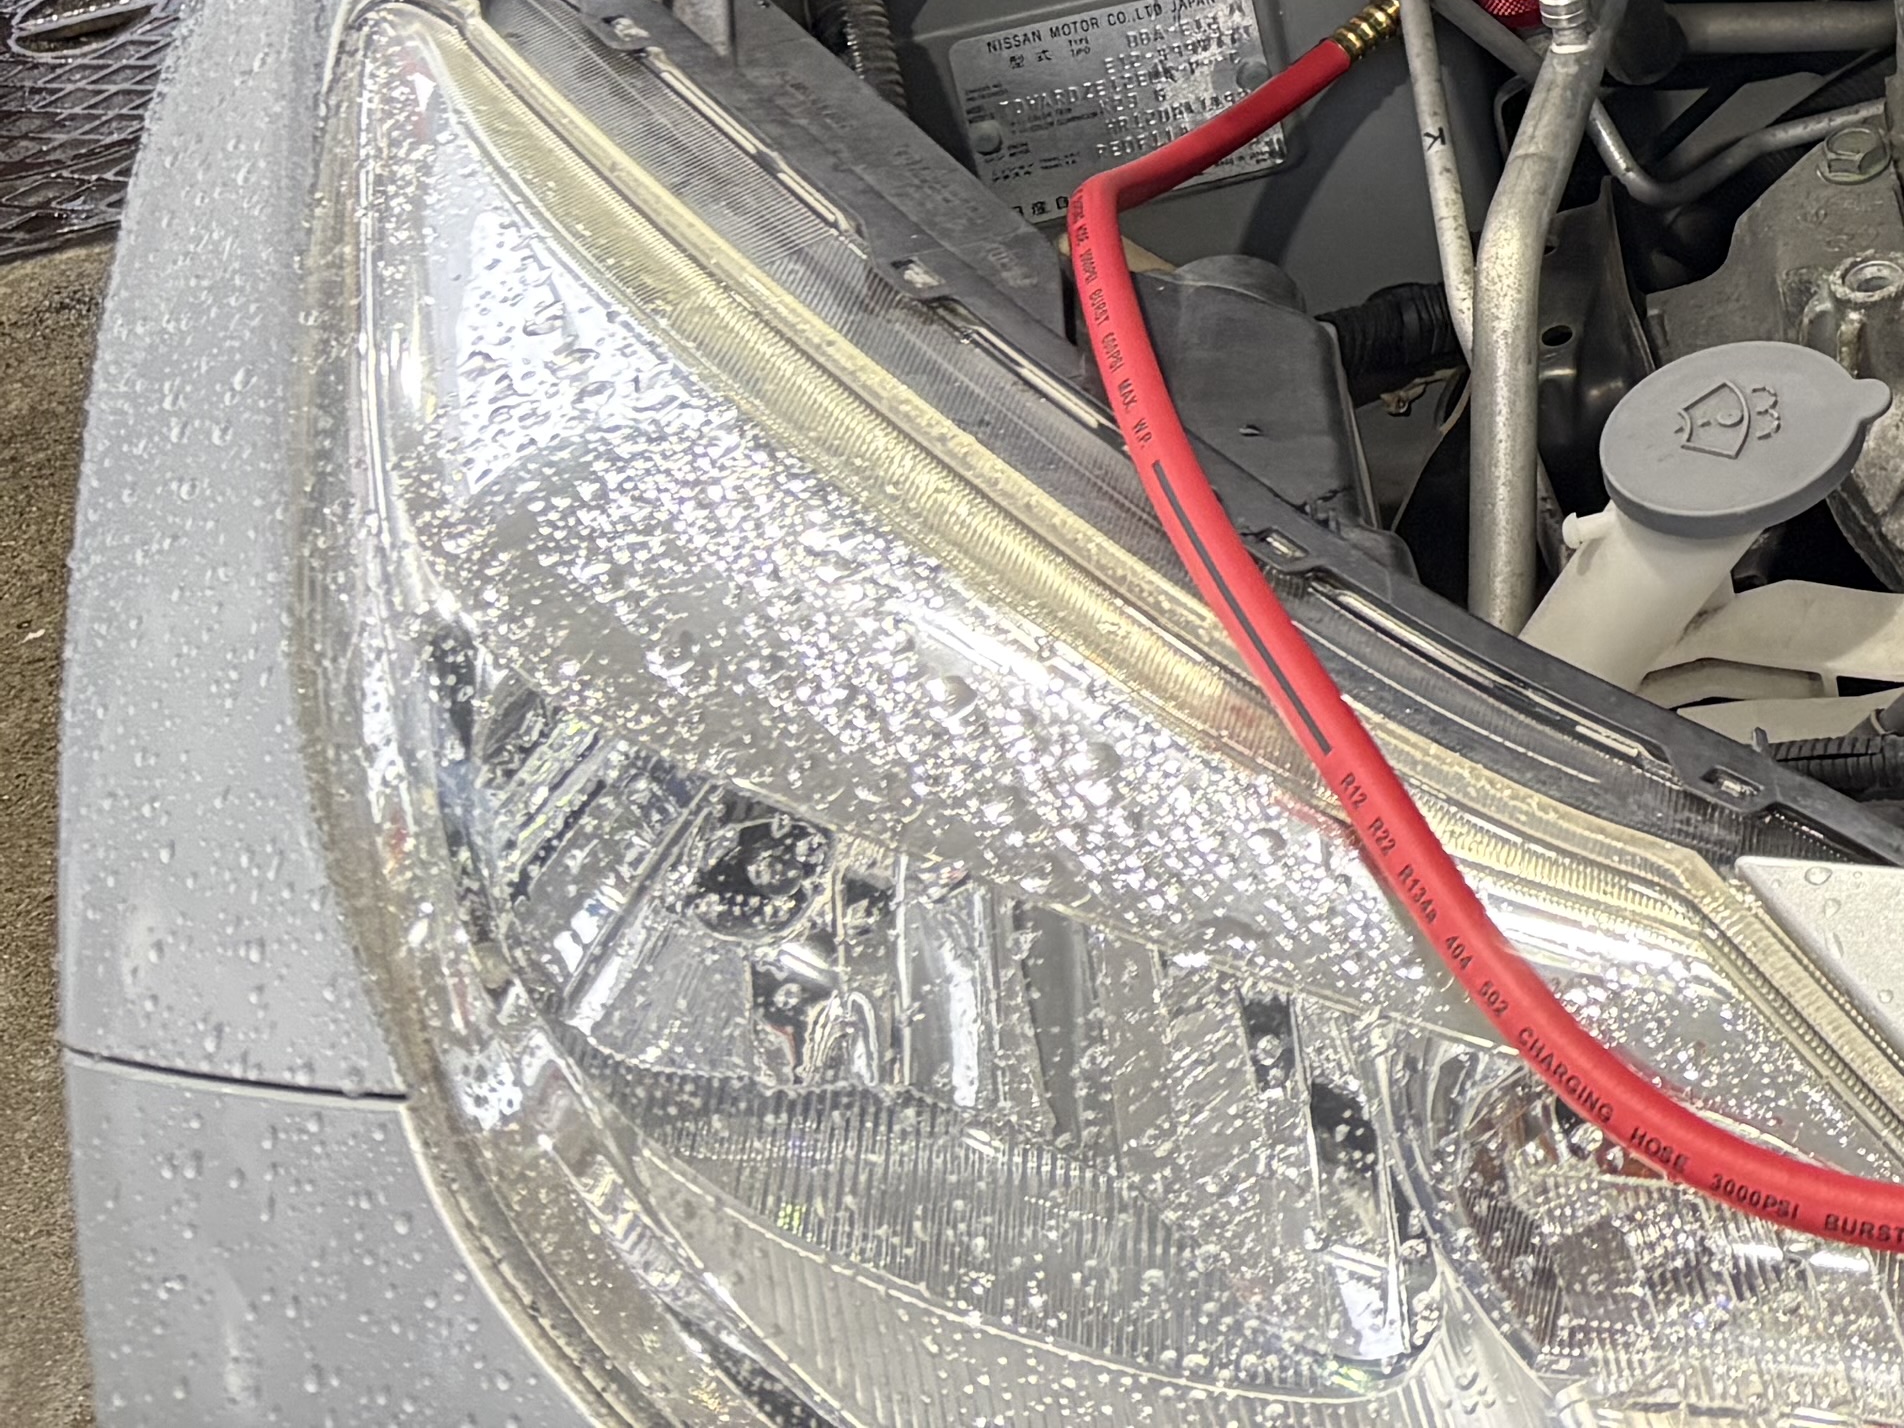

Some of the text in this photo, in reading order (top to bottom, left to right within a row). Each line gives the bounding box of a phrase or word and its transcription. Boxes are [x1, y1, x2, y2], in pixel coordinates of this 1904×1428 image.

[986, 30, 1042, 53] NISSAN
[1050, 17, 1100, 39] MOTOR
[1340, 771, 1368, 810] R12
[1368, 815, 1397, 858] R22
[1445, 934, 1474, 971] 404
[1479, 979, 1509, 1017] 502
[1518, 1026, 1614, 1124] CHARGING
[1630, 1126, 1692, 1174] HOSE
[1711, 1172, 1800, 1222] 3000PSI
